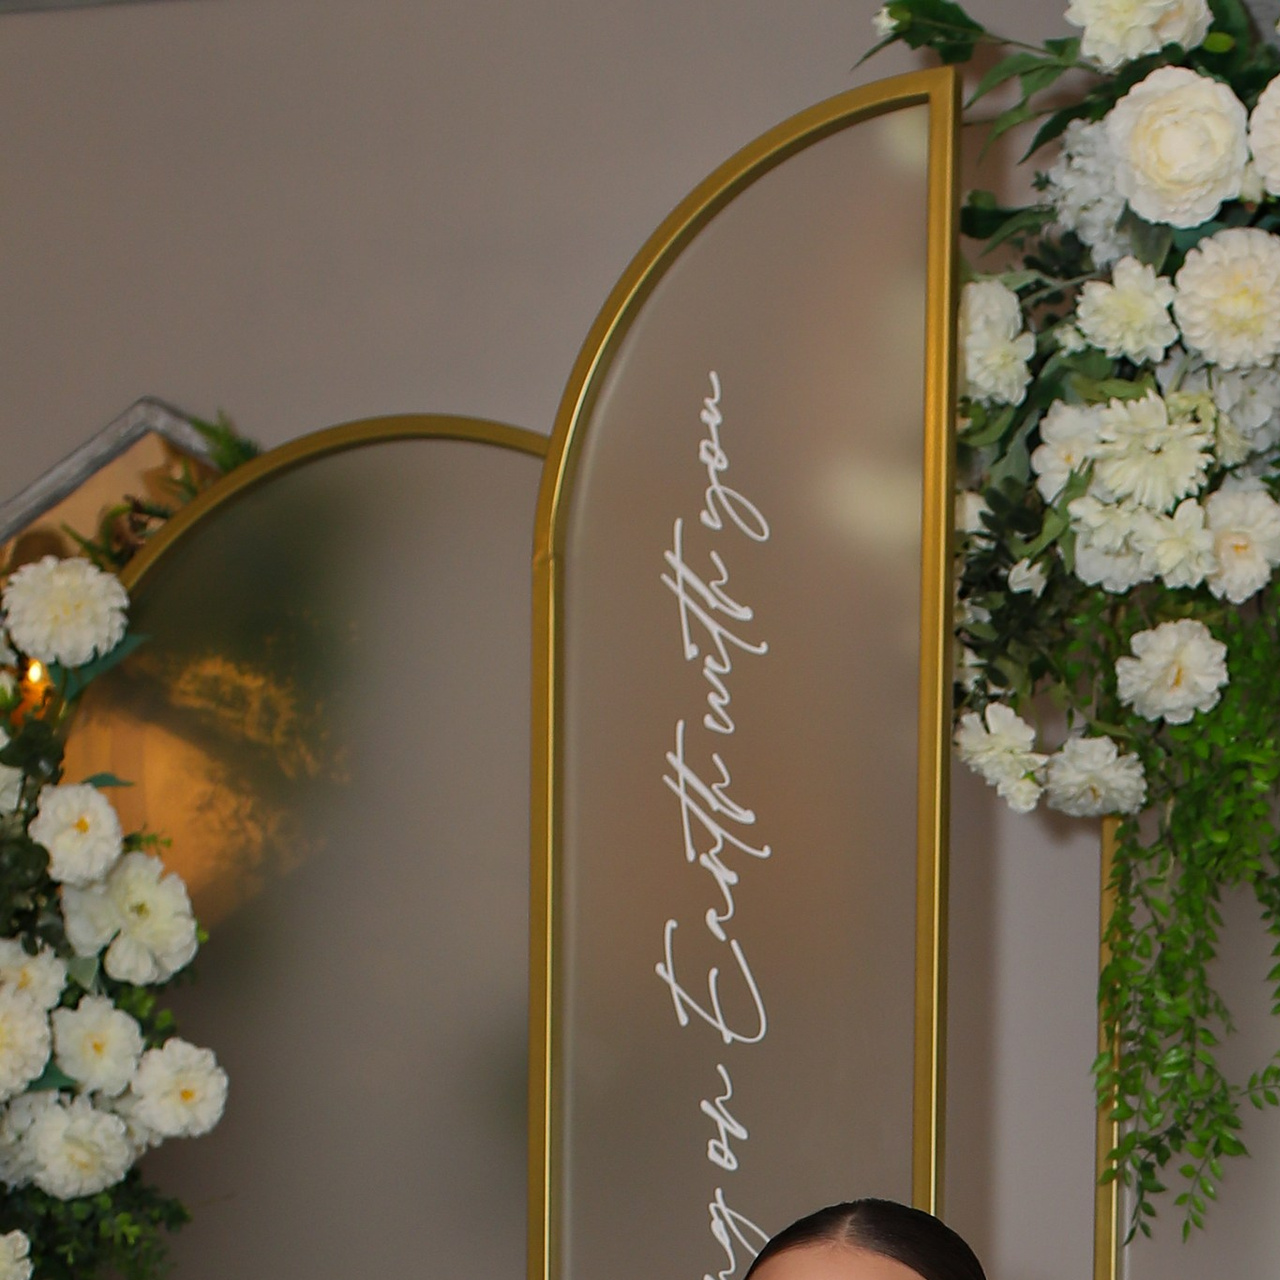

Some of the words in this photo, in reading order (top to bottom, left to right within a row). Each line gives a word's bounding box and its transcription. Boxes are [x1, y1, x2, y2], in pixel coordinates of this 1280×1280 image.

[699, 370, 770, 542] you
[661, 517, 768, 735] with
[655, 719, 771, 1045] Earth
[699, 1064, 749, 1171] on
